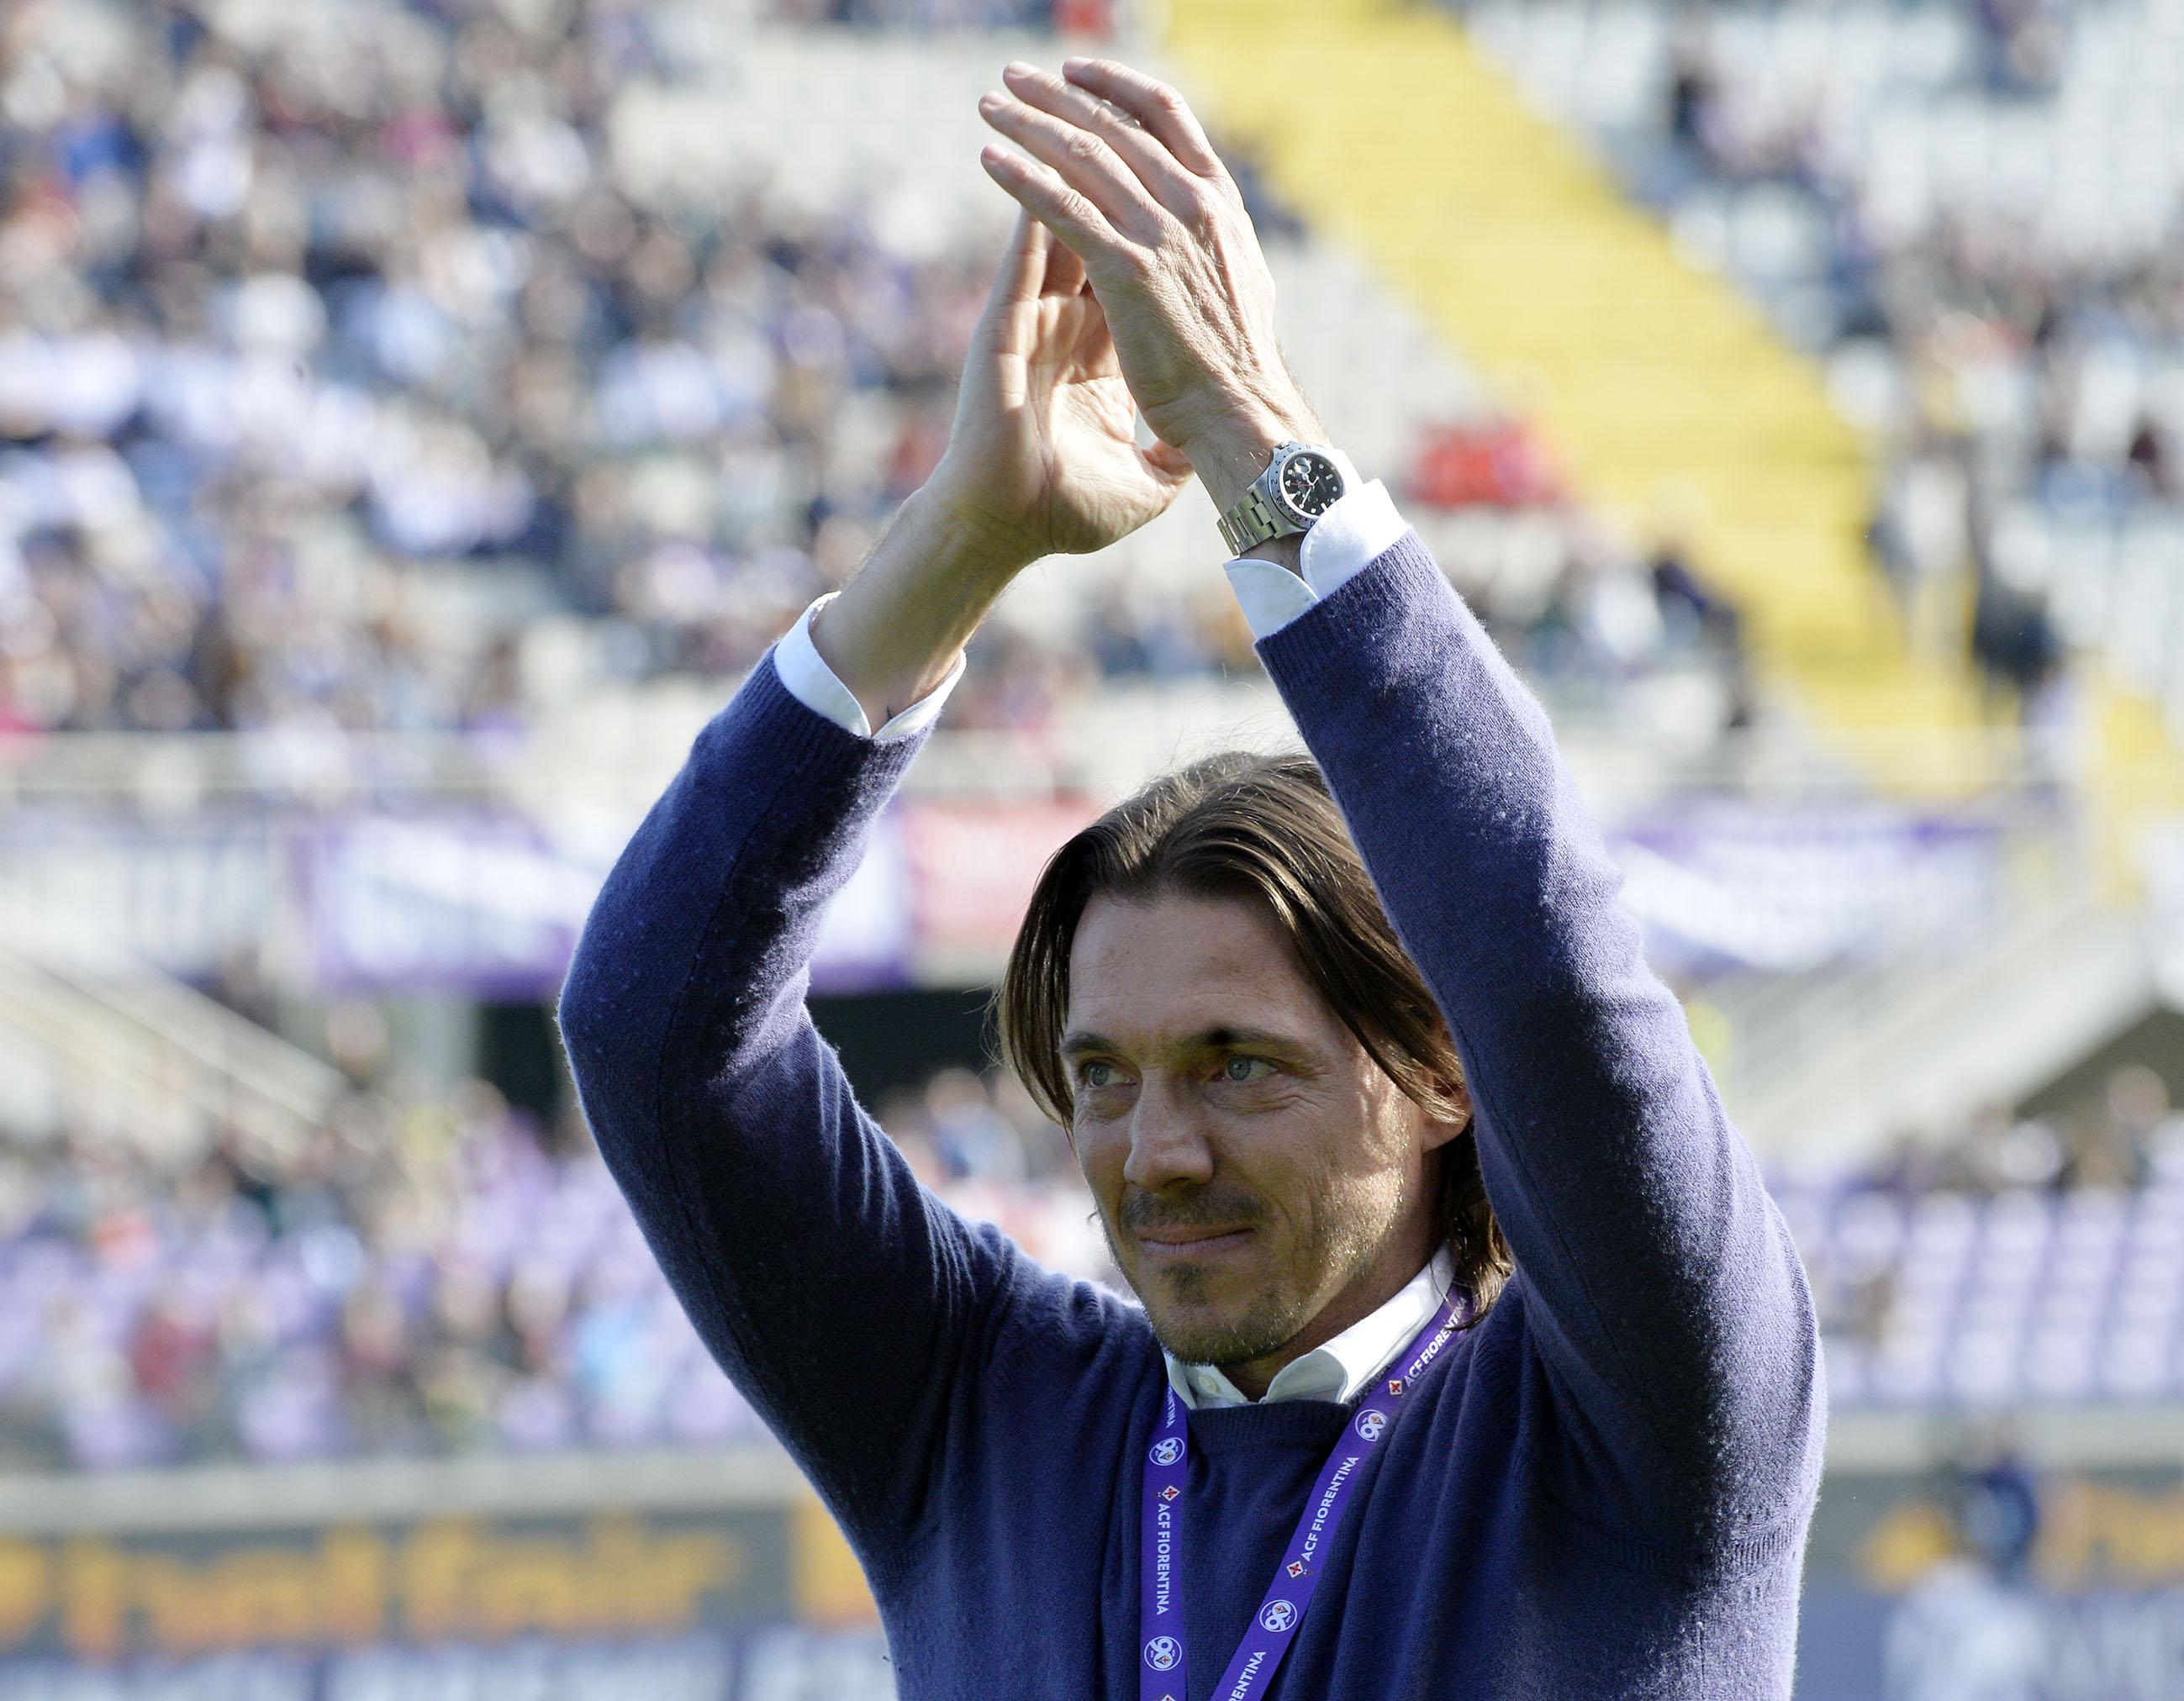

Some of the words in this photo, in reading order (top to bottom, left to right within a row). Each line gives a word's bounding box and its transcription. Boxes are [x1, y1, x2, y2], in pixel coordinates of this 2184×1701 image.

[1405, 1359, 1423, 1387] ACF
[1157, 1503, 1171, 1529] ACF
[1300, 1532, 1319, 1561] ACF
[1311, 1456, 1360, 1532] FIORENTINA
[1157, 1530, 1170, 1616] FIORENTINA
